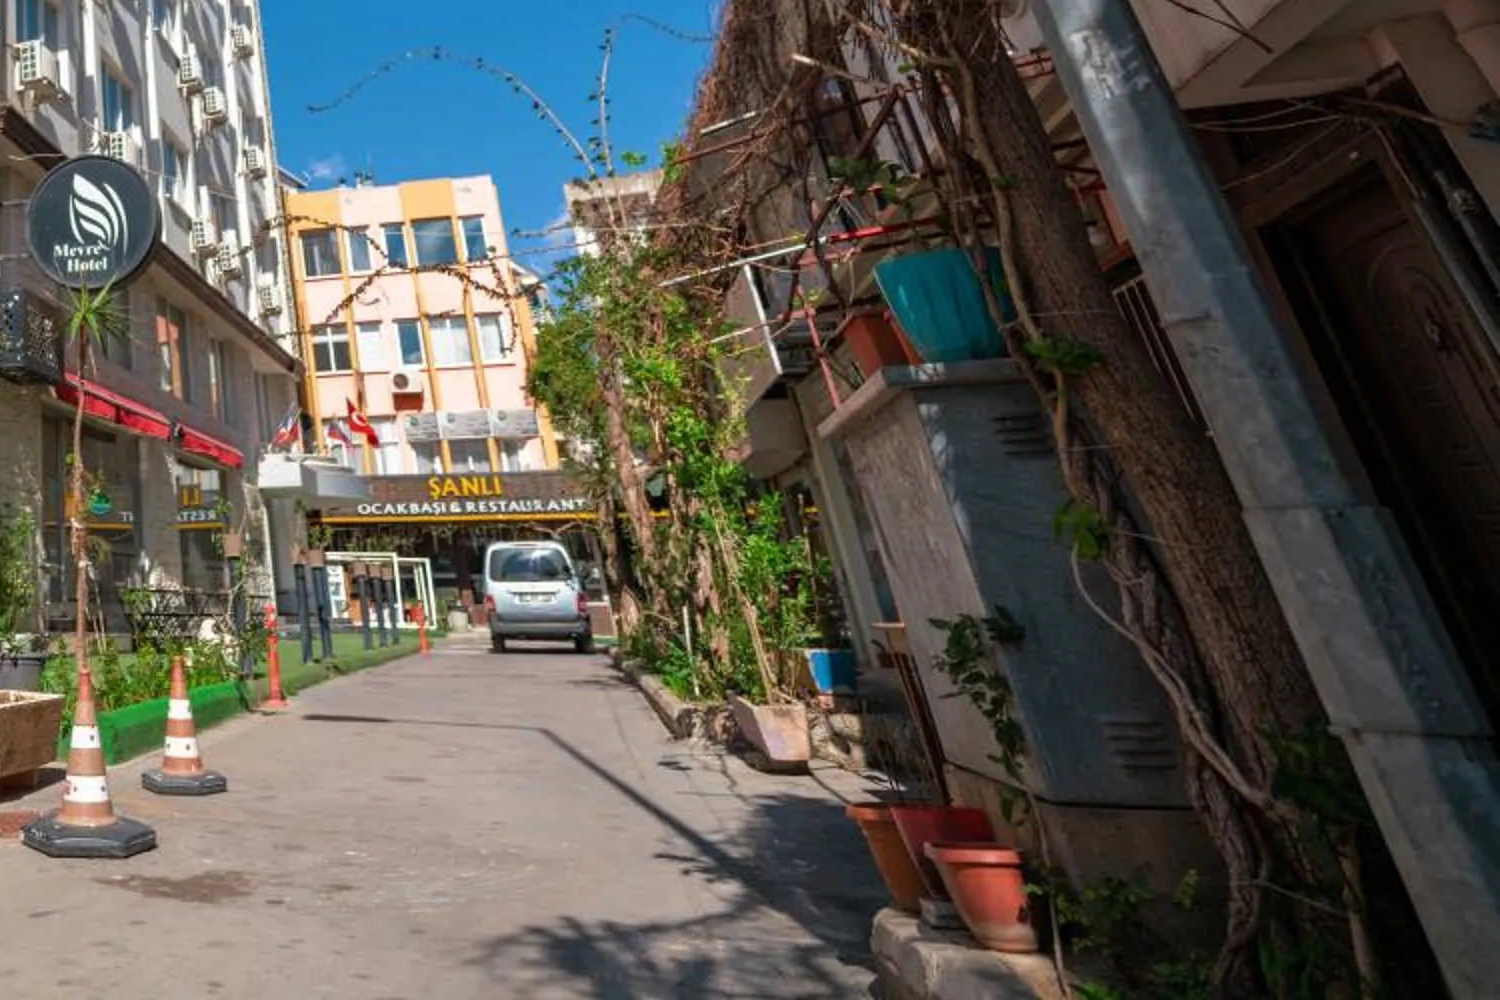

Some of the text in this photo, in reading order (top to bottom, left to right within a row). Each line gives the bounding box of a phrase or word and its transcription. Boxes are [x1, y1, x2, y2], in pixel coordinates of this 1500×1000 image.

[66, 256, 108, 273] Hotel
[428, 476, 504, 501] ŞANLI
[357, 502, 447, 516] OCAKBAŞI
[467, 498, 587, 513] RESTAURANT
